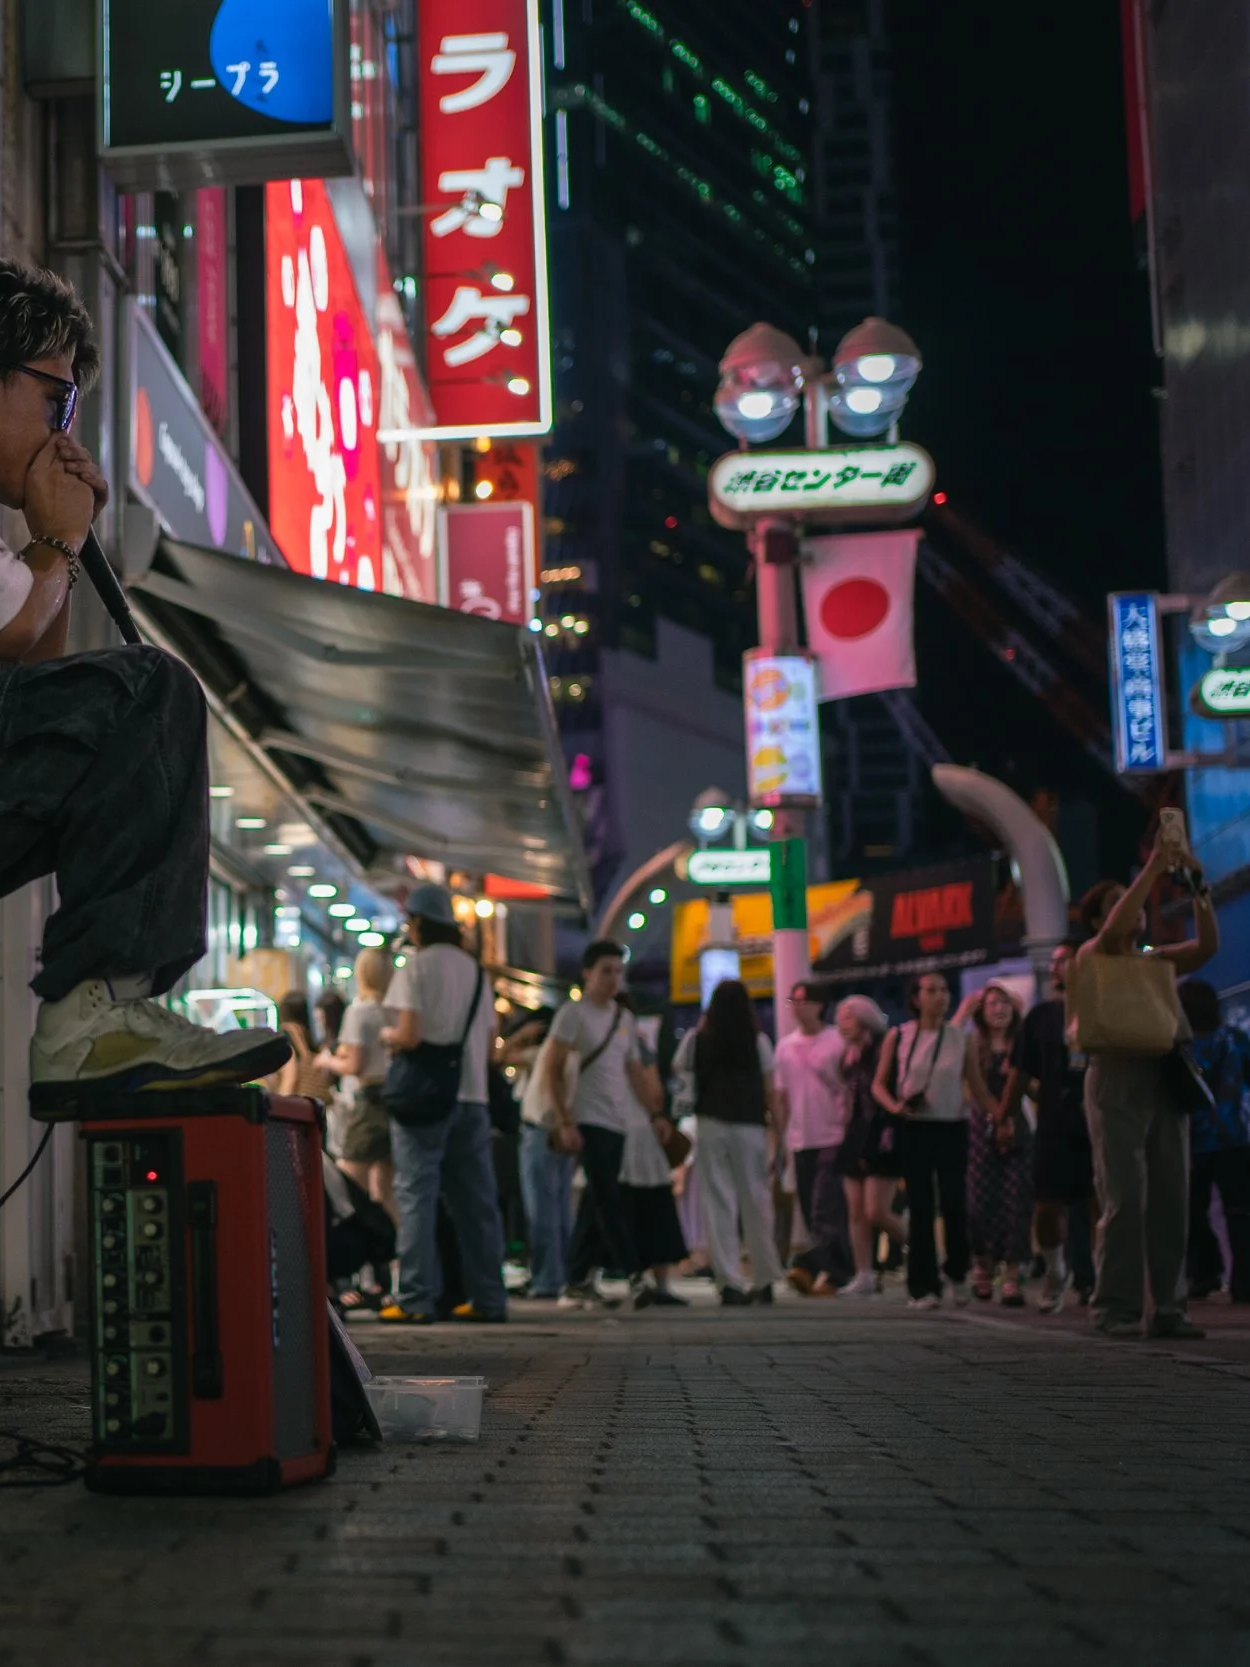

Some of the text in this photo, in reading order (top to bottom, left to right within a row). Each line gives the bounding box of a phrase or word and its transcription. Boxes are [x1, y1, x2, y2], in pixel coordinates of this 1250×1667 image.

[159, 60, 280, 103] シープラ
[723, 460, 918, 494] 渋谷センター街
